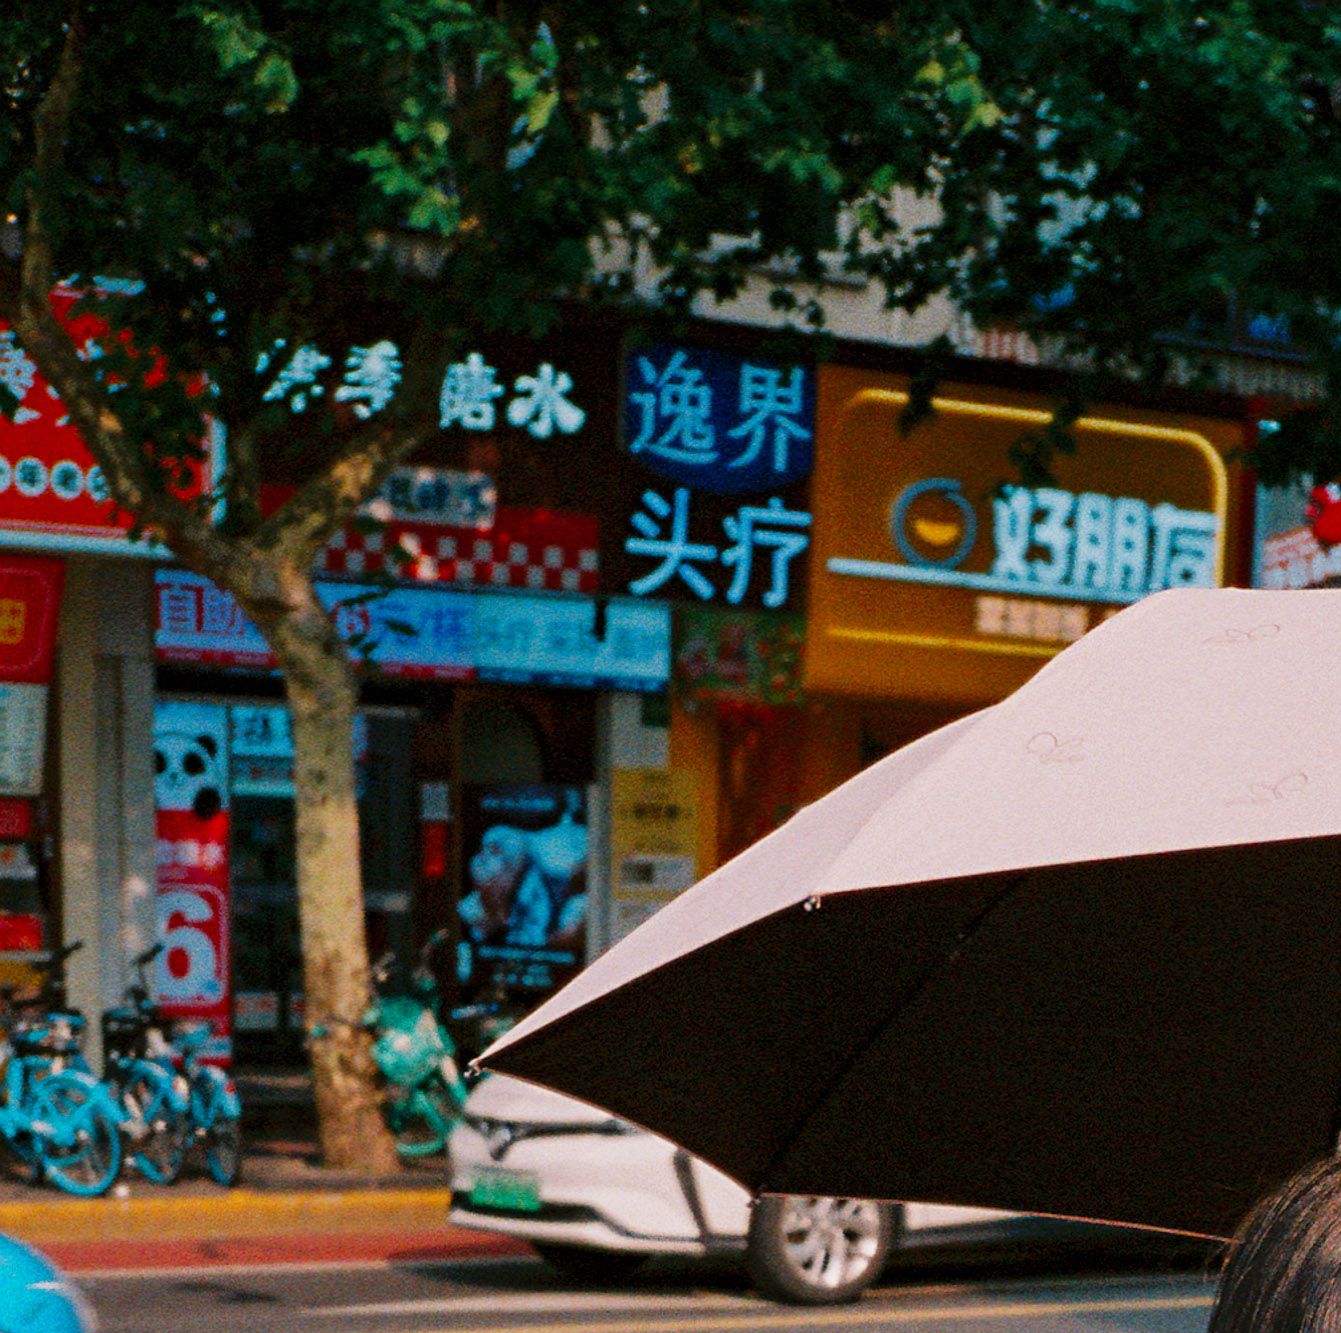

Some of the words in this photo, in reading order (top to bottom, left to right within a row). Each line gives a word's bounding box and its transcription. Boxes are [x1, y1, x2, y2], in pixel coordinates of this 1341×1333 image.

[629, 348, 814, 475] 逸界
[625, 487, 814, 610] 头疗
[155, 890, 221, 1003] 6
